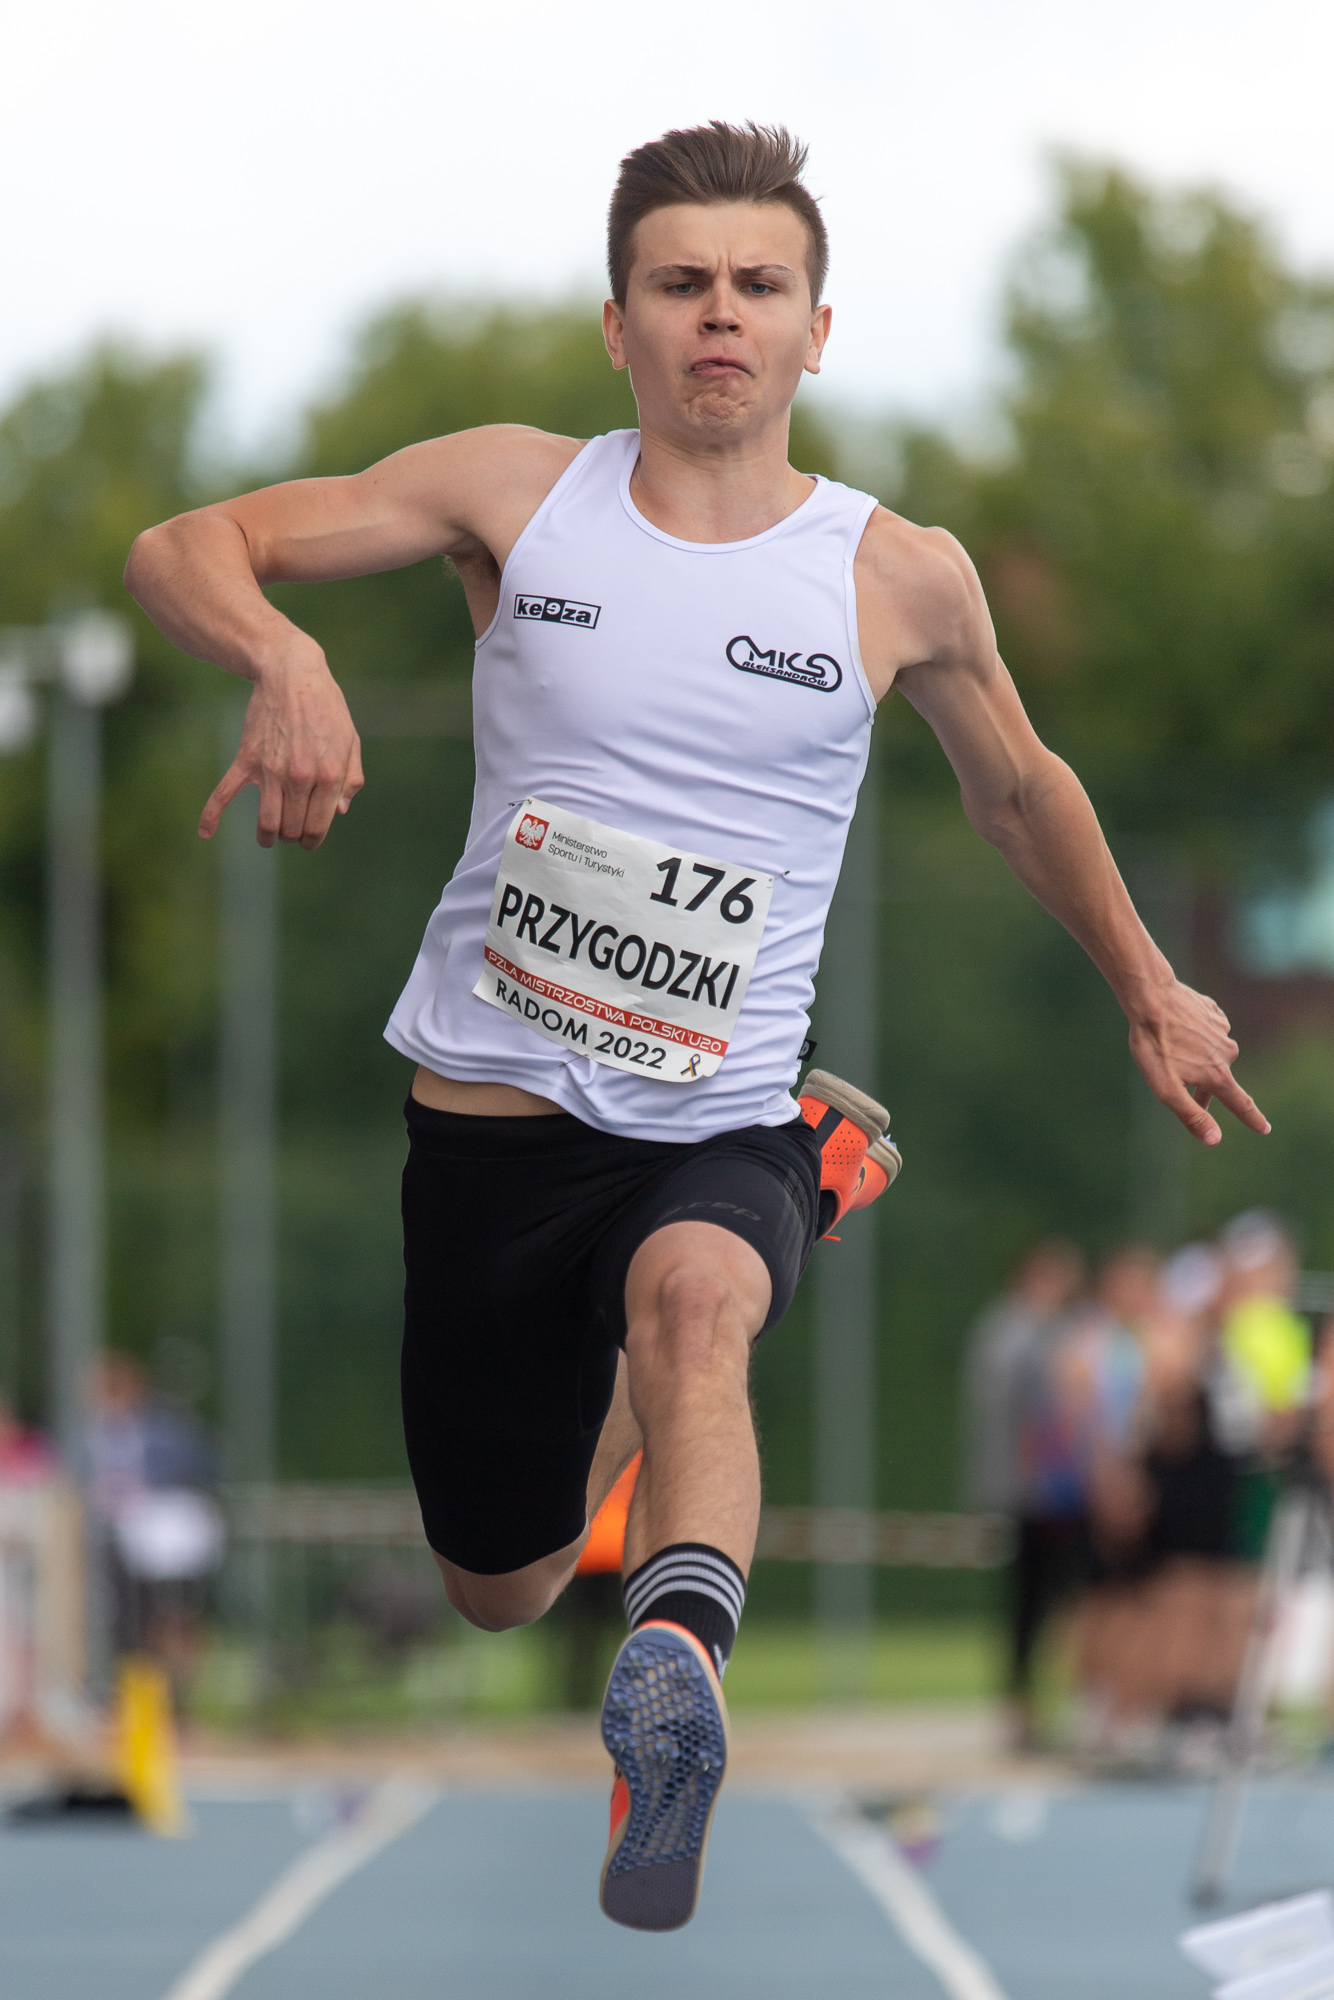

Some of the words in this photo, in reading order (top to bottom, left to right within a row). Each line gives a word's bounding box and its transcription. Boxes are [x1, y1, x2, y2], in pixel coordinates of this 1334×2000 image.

[548, 843, 578, 862] Sportu
[578, 854, 583, 864] i
[584, 856, 626, 878] Turystyki
[552, 831, 608, 859] Ministerstwo
[650, 857, 757, 924] 176
[496, 883, 741, 1011] PRZYGODZKI
[488, 951, 518, 979] PZLA
[520, 973, 626, 1024] MISTRZOSTWA
[629, 1015, 686, 1043] POLSKI
[689, 1033, 722, 1053] U20
[496, 977, 588, 1045] RADOM
[594, 1031, 667, 1070] 2022
